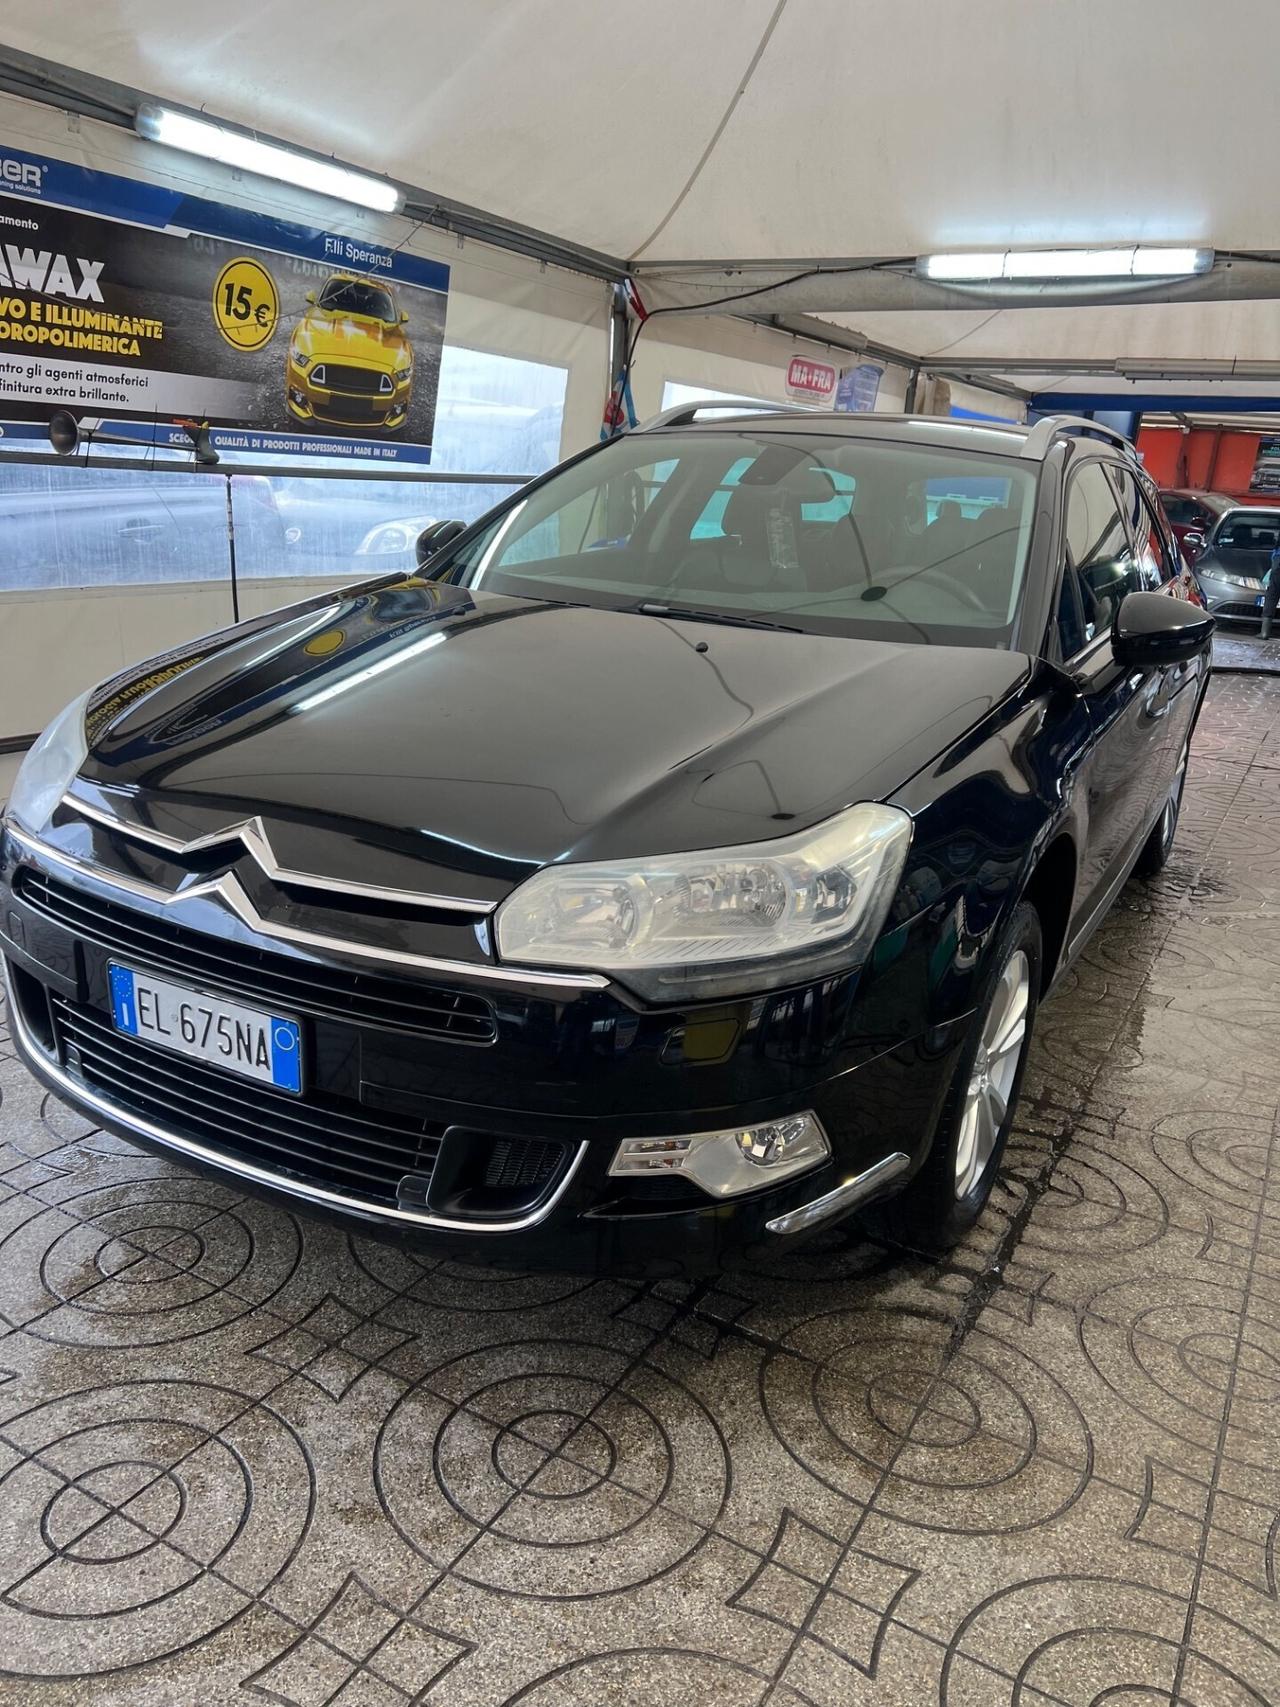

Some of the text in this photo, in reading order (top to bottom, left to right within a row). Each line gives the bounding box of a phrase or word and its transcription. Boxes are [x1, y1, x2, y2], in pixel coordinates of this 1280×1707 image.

[346, 243, 393, 269] Speranza
[30, 301, 41, 322] E
[45, 303, 163, 340] ILLUMINANTE
[0, 320, 141, 357] OROPOLIMERICA
[26, 363, 42, 379] gli
[45, 369, 83, 382] agenti
[86, 373, 149, 388] atmosferici
[45, 386, 76, 398] extra
[79, 386, 130, 403] brillante.
[214, 436, 249, 448] QUALITÀ
[251, 438, 261, 448] DI
[262, 440, 300, 450] PRODOTTI
[302, 442, 352, 454] PROFESSIONALI
[353, 446, 373, 456] MADE
[373, 447, 381, 457] IN
[382, 449, 398, 457] ITALY
[137, 987, 271, 1071] EL 675NA
